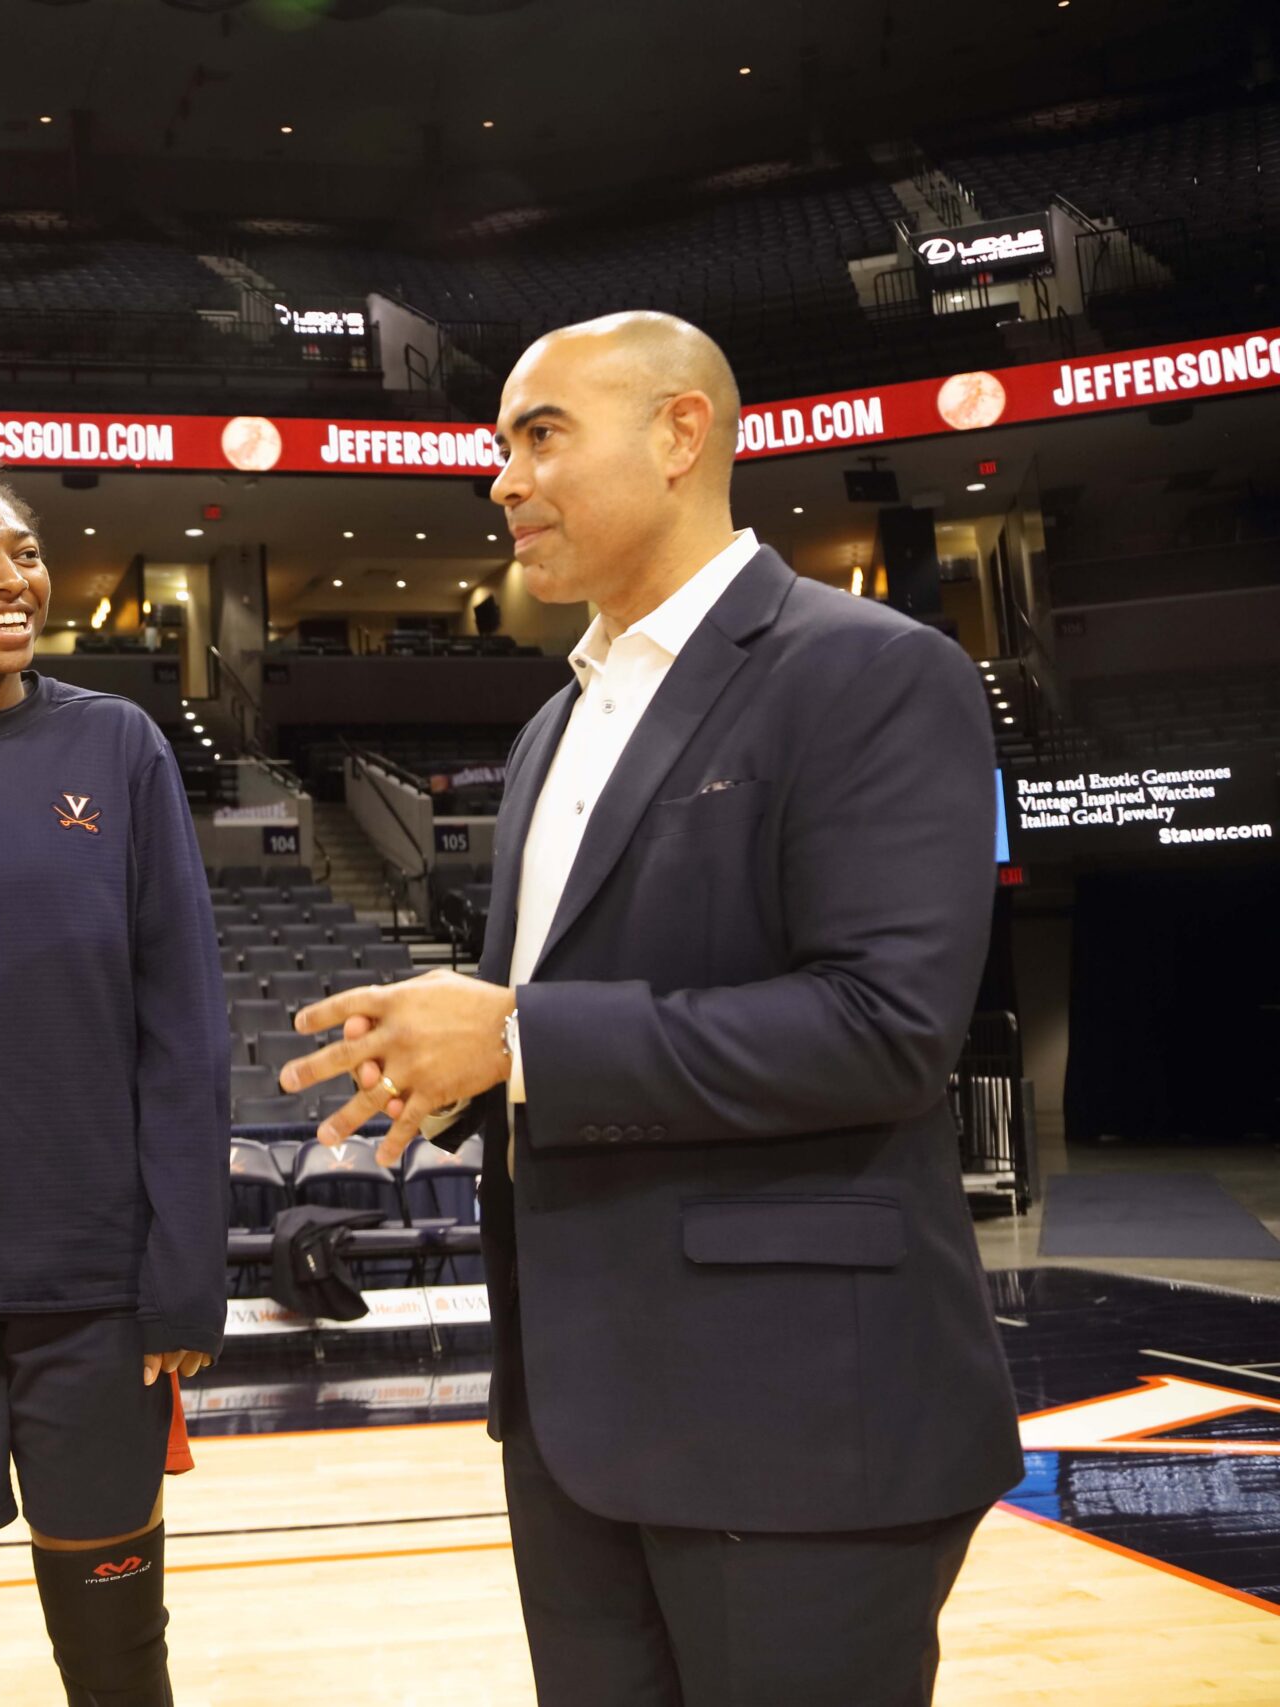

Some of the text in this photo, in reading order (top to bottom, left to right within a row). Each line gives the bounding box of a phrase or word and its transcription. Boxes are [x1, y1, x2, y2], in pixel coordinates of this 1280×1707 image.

[1017, 767, 1231, 795] Rare and Exotic Gemstones
[63, 793, 91, 819] V
[1018, 784, 1215, 813] Vintage Inspired Watches
[1020, 804, 1175, 829] Italian Gold Jewelry
[270, 835, 296, 852] 104
[441, 834, 467, 850] 105
[1158, 823, 1272, 844] Stauer.com
